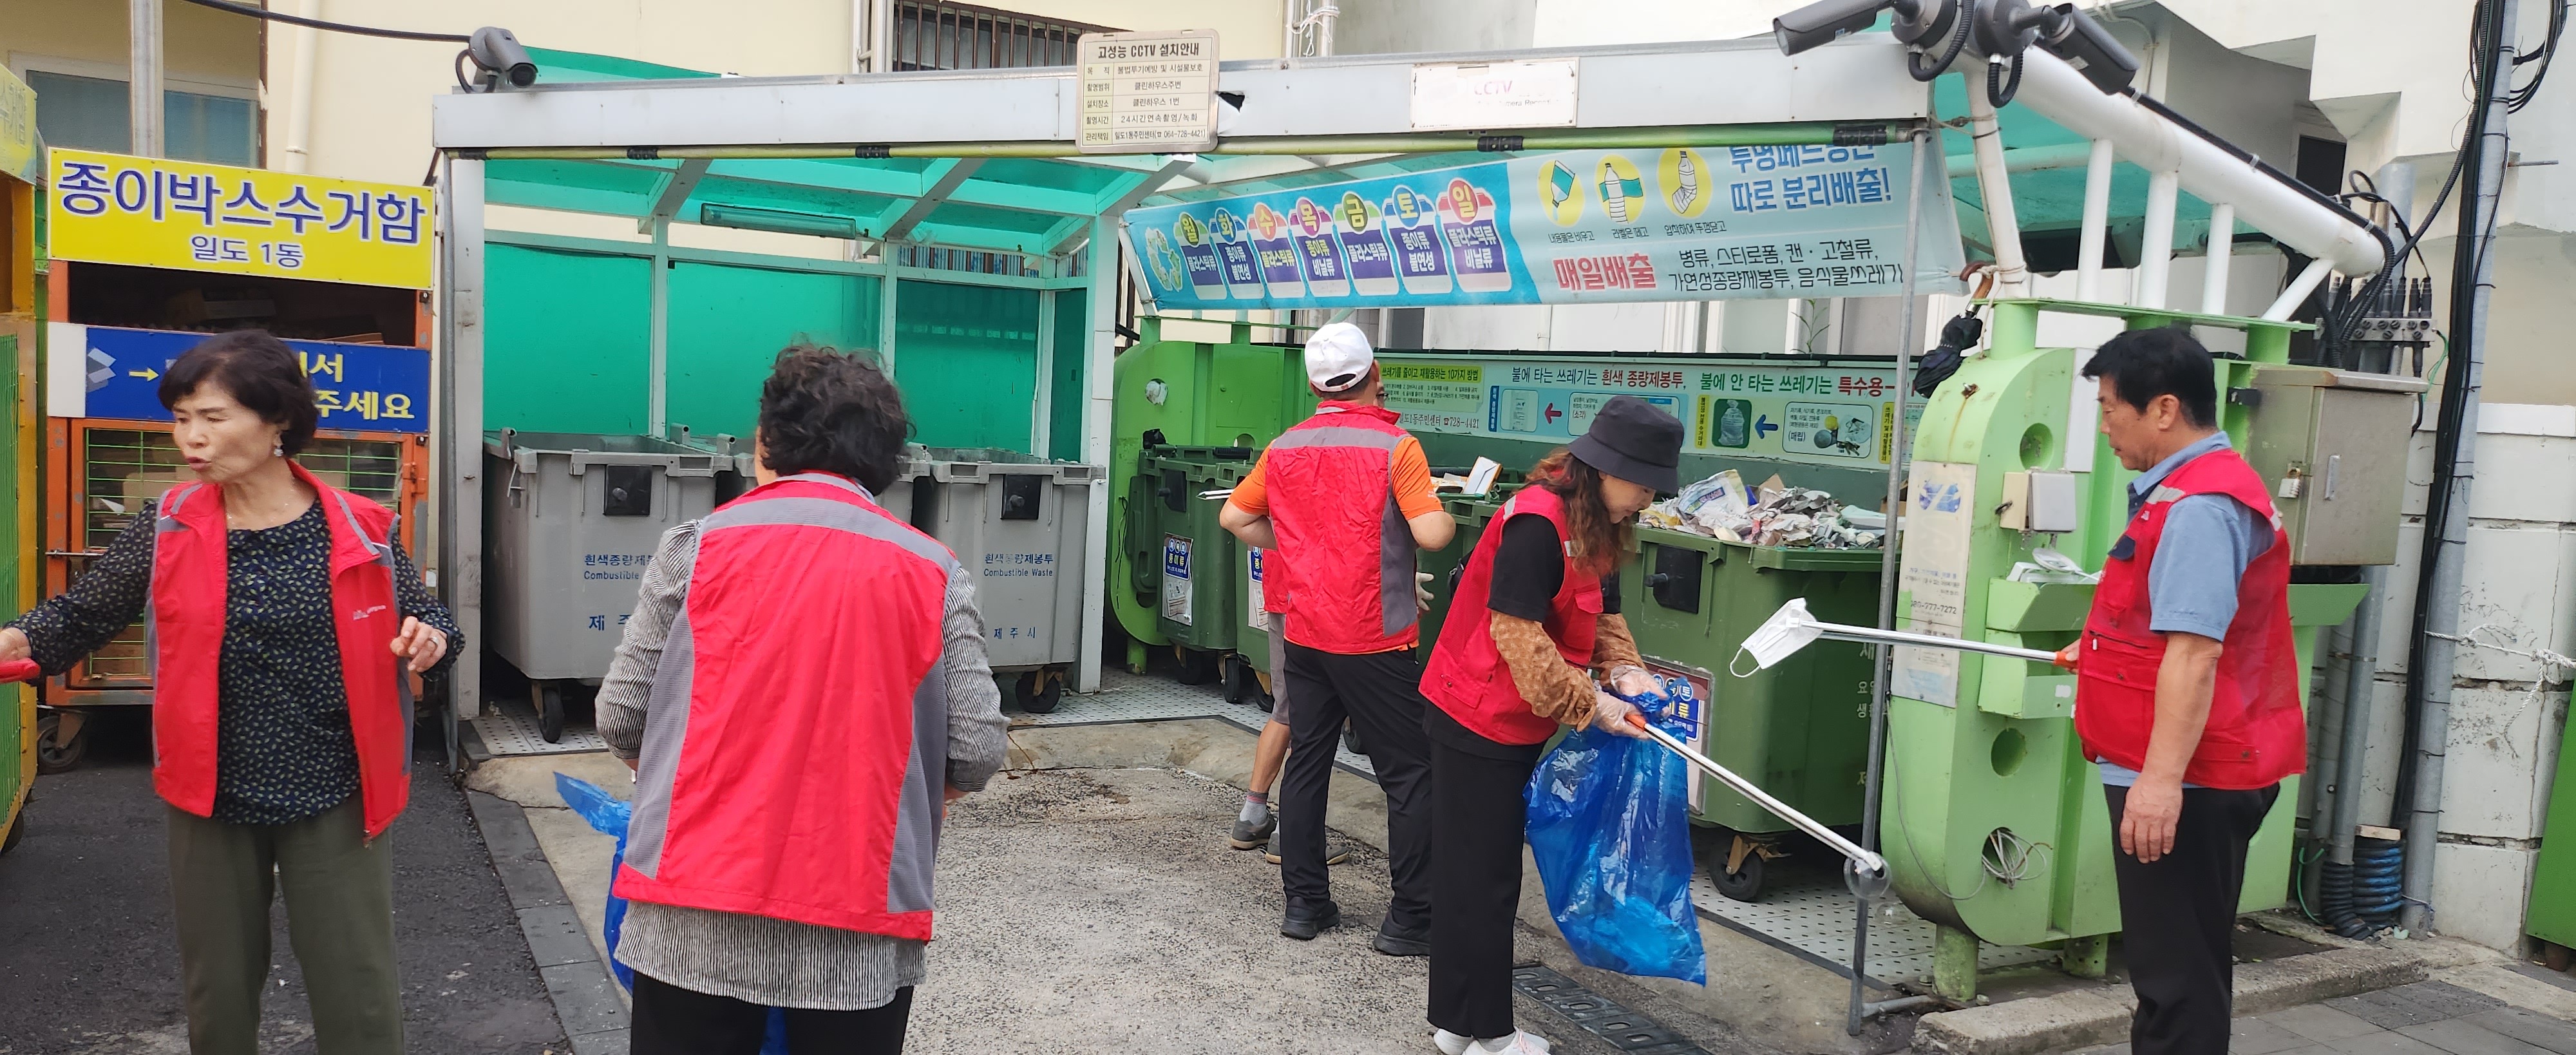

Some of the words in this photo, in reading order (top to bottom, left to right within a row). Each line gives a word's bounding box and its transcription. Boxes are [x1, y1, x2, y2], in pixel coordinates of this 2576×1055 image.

[1098, 45, 1126, 59] 고성능
[1131, 44, 1156, 57] CCTV
[1160, 43, 1199, 57] 설치안내
[1117, 66, 1157, 75] 불법투기예방
[1170, 64, 1203, 72] 시설물보호
[1087, 83, 1110, 91] 촬영범위
[1474, 81, 1512, 95] CCTV
[1087, 99, 1109, 108] 설치장소
[1133, 97, 1166, 107] 클린하우스
[1170, 97, 1179, 106] 1번
[1731, 179, 1779, 214] 따로
[1784, 168, 1891, 209] 분리배출!
[58, 162, 426, 245] 종이박스수거함
[1396, 193, 1417, 220] 토
[1452, 185, 1475, 218] 일
[1258, 210, 1274, 233] 수
[1300, 207, 1317, 231] 목
[1345, 200, 1364, 228] 금
[1180, 216, 1197, 243] 월
[1218, 214, 1232, 238] 화
[1665, 223, 1695, 236] 압착하여
[1401, 231, 1430, 251] 종이류
[1446, 226, 1497, 247] 플라스틱류
[191, 235, 249, 262] 일도
[260, 242, 303, 269] 1동
[1224, 245, 1247, 262] 종이류
[1305, 238, 1330, 257] 종이류
[1349, 243, 1389, 263] 플라스틱류
[1679, 249, 1715, 268] 병류,
[1717, 246, 1784, 266] 스티로폼,
[1785, 244, 1804, 263] 캔
[1819, 239, 1879, 262] 고철류,
[1188, 252, 1217, 272] 플라스틱류
[1260, 249, 1294, 269] 플라스틱류
[1311, 257, 1336, 277] 비닐류
[1408, 252, 1435, 272] 불연성
[1464, 248, 1493, 269] 비닐류
[1229, 263, 1251, 281] 불연성
[1553, 252, 1657, 292] 매일배출
[1669, 267, 1795, 292] 가연성종량제봉투,
[1798, 262, 1905, 287] 음식물쓰레기
[1382, 366, 1401, 377] 쓰레기를
[1403, 367, 1418, 379] 줄이고
[1419, 368, 1446, 379] 재활용하는
[1448, 369, 1465, 380] 10가지
[1467, 370, 1479, 381] 방법
[1512, 367, 1530, 383] 불에
[1534, 368, 1553, 383] 타는
[1556, 369, 1598, 385] 쓰레기는
[1602, 369, 1623, 386] 흰색
[1627, 370, 1686, 390] 종량제봉투,
[1701, 373, 1725, 390] 불에
[1730, 374, 1743, 391] 안
[1748, 374, 1774, 392] 타는
[1779, 375, 1832, 394] 쓰레기는
[315, 389, 415, 420] 주세요
[1572, 410, 1586, 419] (소각)
[1788, 431, 1806, 442] (매립)
[985, 554, 1054, 564] 흰색종량제봉투
